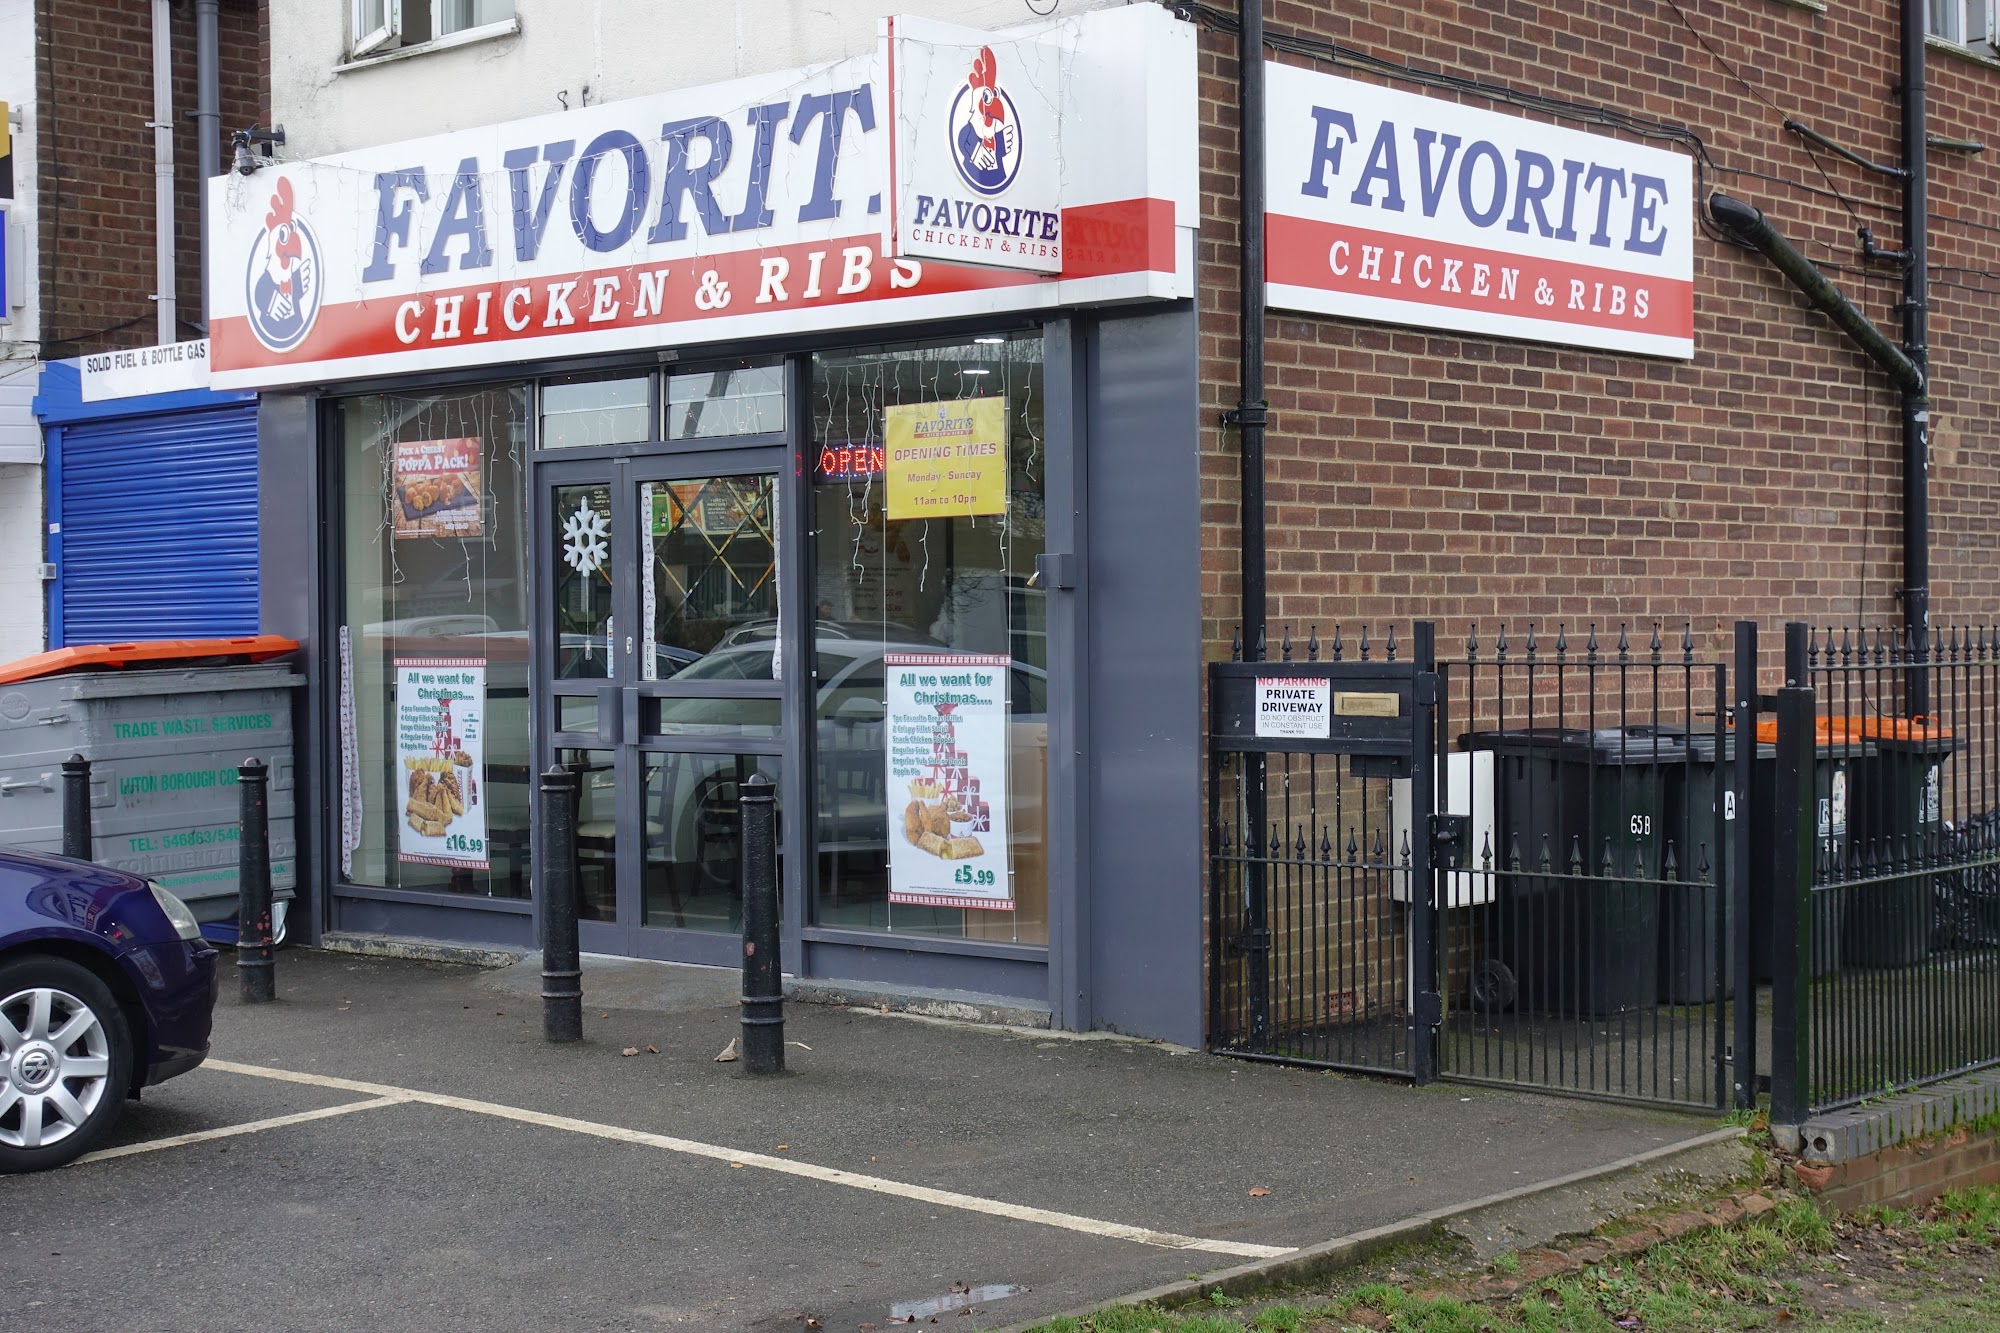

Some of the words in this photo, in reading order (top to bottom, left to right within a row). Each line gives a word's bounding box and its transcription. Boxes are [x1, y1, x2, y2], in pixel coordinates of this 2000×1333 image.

[362, 83, 881, 283] FAVORIT
[1301, 105, 1668, 256] FAVORITE
[914, 194, 1058, 240] FAVORITE
[913, 229, 993, 250] CHICKEN
[1001, 240, 1010, 252] &
[1019, 242, 1058, 258] RIBS
[1329, 240, 1520, 300] CHICKEN
[1534, 278, 1554, 306] &
[1568, 279, 1649, 319] RIBS
[395, 269, 670, 344] CHICKEN
[695, 270, 732, 311] &
[756, 246, 922, 304] RIBS
[87, 356, 111, 373] SOLID
[115, 353, 137, 369] FUEL
[142, 351, 147, 366] &
[152, 346, 182, 364] BOTTLE
[187, 343, 205, 360] GAS
[914, 418, 974, 432] FAVORITE
[399, 447, 413, 456] PICK
[420, 445, 446, 454] CHEESY
[894, 446, 951, 461] OPENING
[956, 443, 997, 457] TIMES
[398, 456, 432, 472] POPPA
[434, 454, 468, 470] PACK!
[822, 448, 884, 473] OPEN
[907, 472, 941, 482] Monday
[948, 471, 982, 481] Sunday
[914, 497, 937, 506] 11am
[940, 496, 948, 504] to
[952, 495, 977, 505] 10pm
[408, 672, 419, 684] All
[422, 676, 435, 684] we
[437, 674, 460, 684] want
[462, 673, 475, 684] for
[900, 674, 916, 686] All
[919, 676, 937, 686] we
[940, 674, 972, 686] want
[974, 672, 993, 686] for
[1258, 677, 1274, 686] NO
[1277, 677, 1327, 686] PARKING
[1266, 690, 1315, 699] PRIVATE
[1262, 703, 1322, 713] DRIVEWAY
[903, 714, 927, 722] Favorite
[928, 715, 947, 723] Breast
[113, 722, 158, 738] TRADE
[212, 714, 272, 732] SERVICES
[897, 726, 916, 735] Crispy
[916, 725, 931, 733] Fillet
[932, 726, 949, 734] Strips
[893, 736, 909, 744] Snack
[933, 736, 955, 744] Poppas
[892, 746, 914, 755] Regular
[915, 746, 930, 754] Fries
[892, 757, 915, 766] Regular
[915, 757, 927, 765] Tub
[927, 756, 940, 765] Side
[893, 767, 910, 776] Apple
[910, 767, 920, 776] Pie
[120, 776, 157, 795] LUTON
[161, 770, 216, 791] BOROUGH
[129, 838, 158, 852] TEL:
[446, 834, 483, 852] £16.99
[955, 864, 995, 885] £5.99
